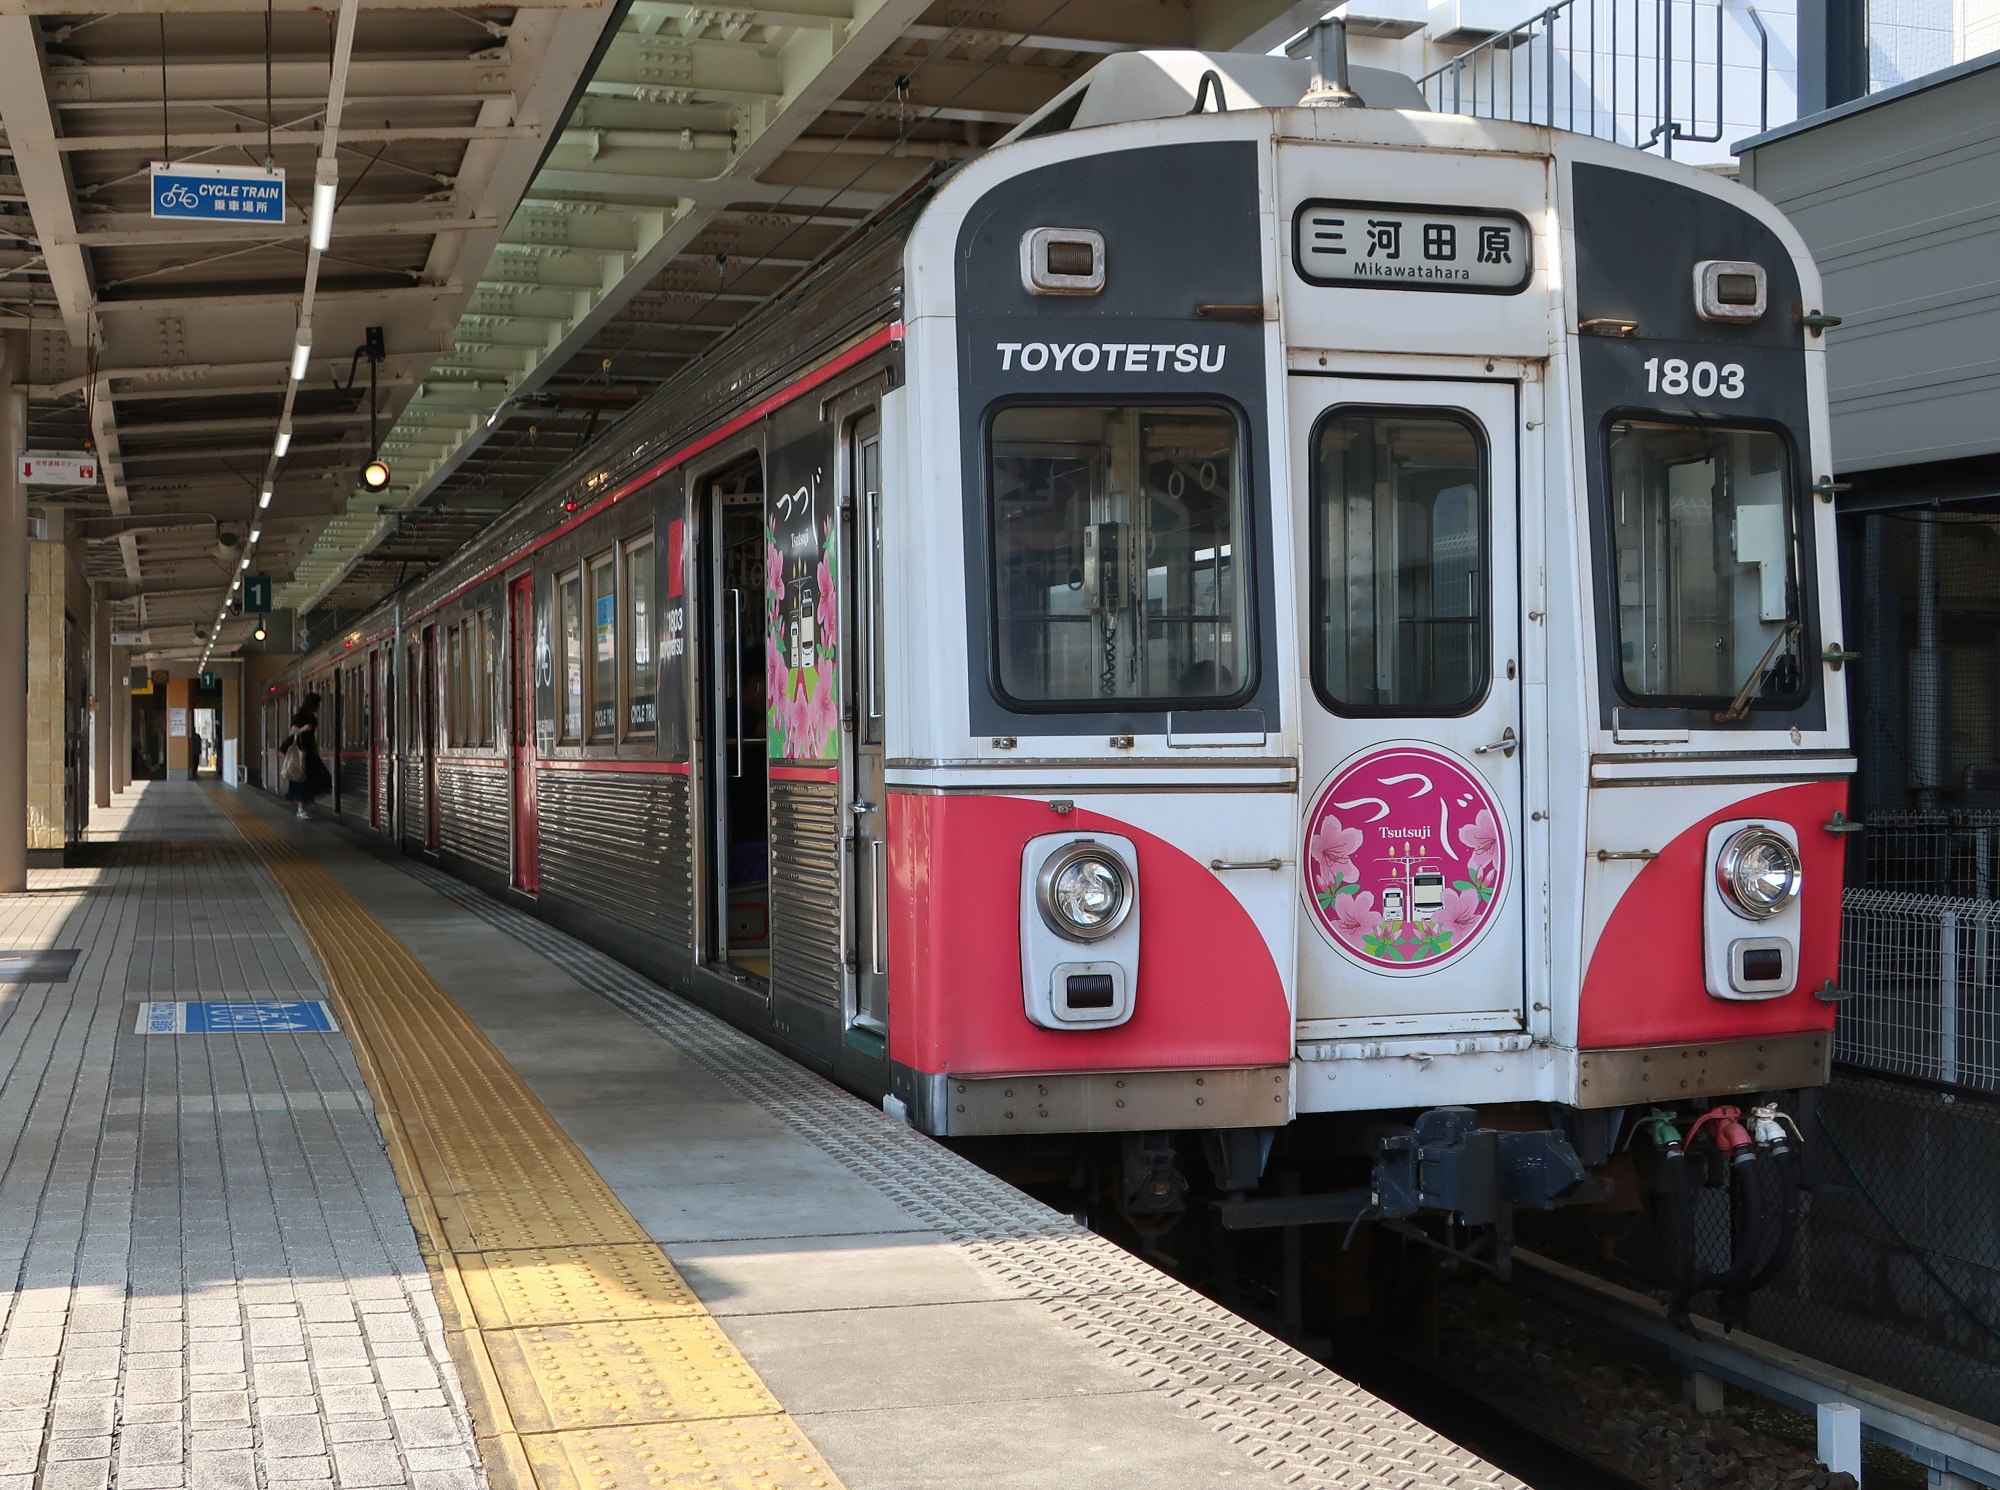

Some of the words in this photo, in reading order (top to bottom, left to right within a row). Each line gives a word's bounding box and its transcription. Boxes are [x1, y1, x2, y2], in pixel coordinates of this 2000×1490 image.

[198, 184, 239, 197] CYCLE
[241, 186, 279, 199] TRAIN
[214, 199, 268, 213] 乗車場所
[1311, 218, 1513, 264] 三河田原
[1354, 261, 1470, 280] Mikawatahara
[996, 342, 1227, 373] TOYOTETSU
[1643, 357, 1745, 399] 1803
[776, 467, 822, 546] つつじ
[790, 528, 809, 548] Tsutsuji
[250, 584, 261, 605] 1
[668, 606, 683, 632] 1803
[204, 674, 210, 685] 1
[1333, 773, 1474, 861] つつじ
[1378, 825, 1431, 840] Tsutsuji
